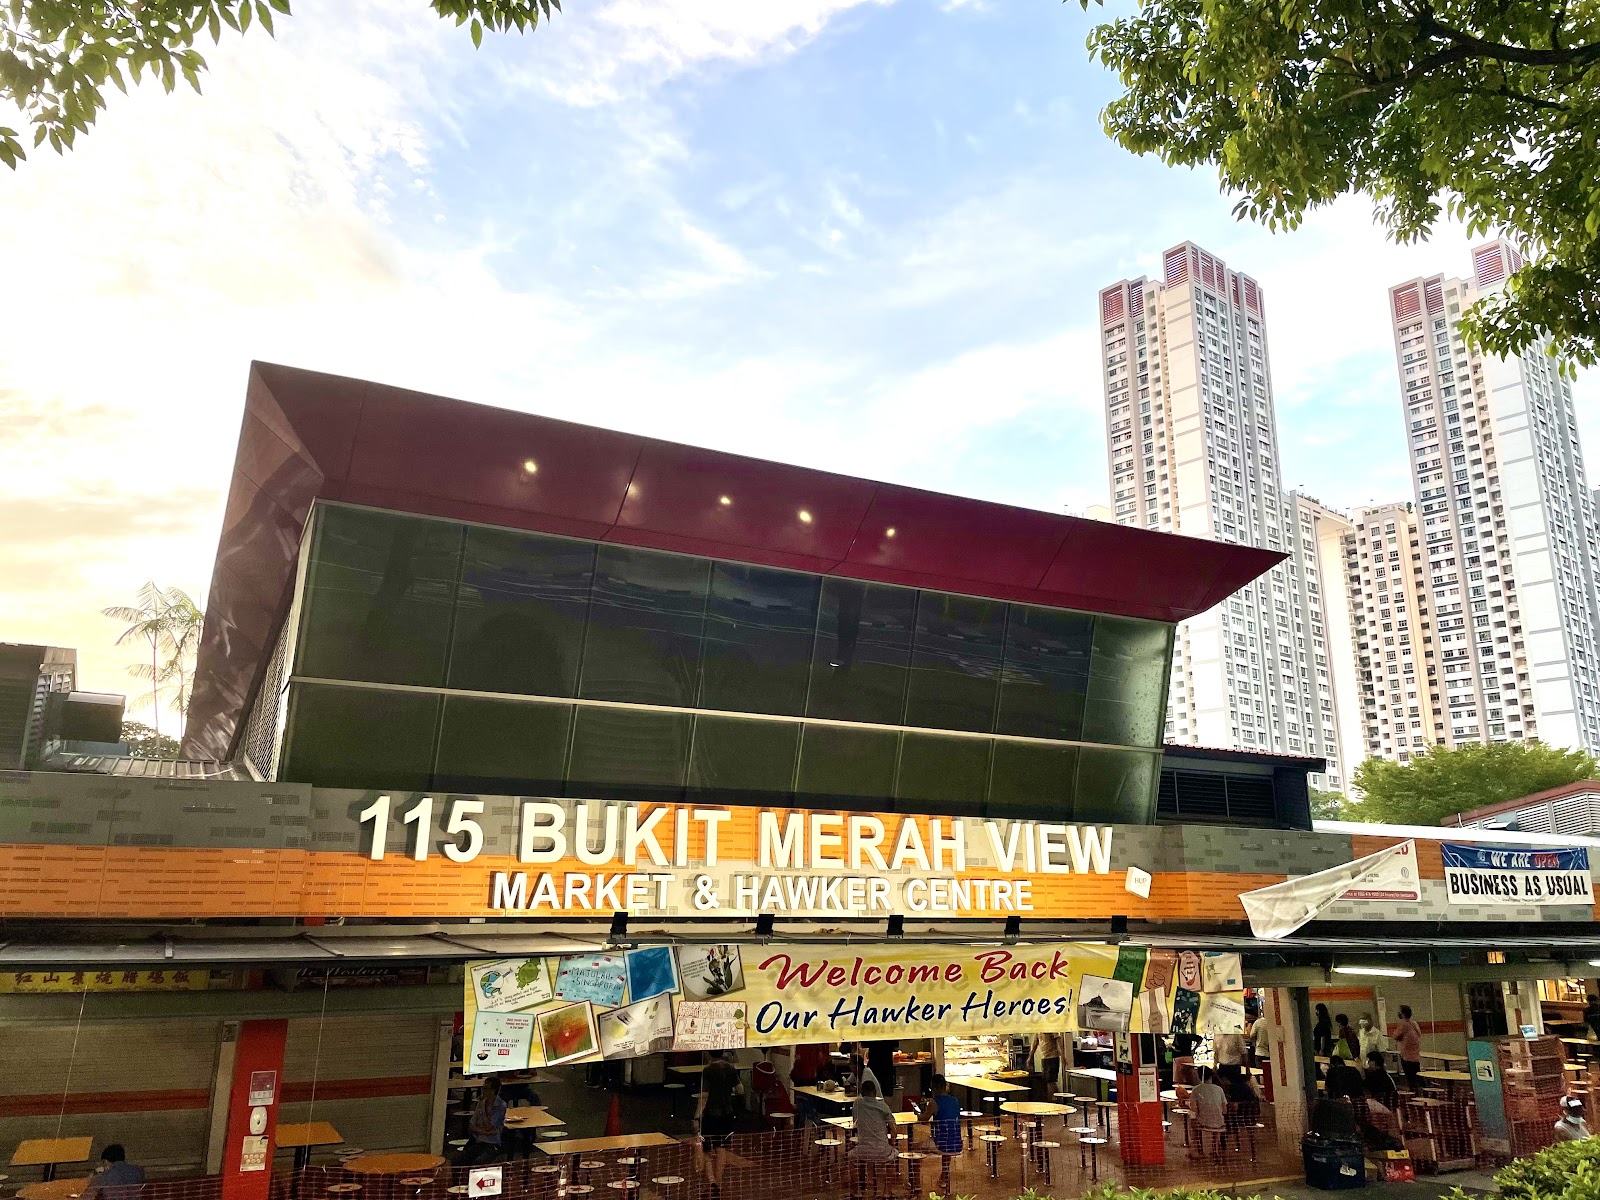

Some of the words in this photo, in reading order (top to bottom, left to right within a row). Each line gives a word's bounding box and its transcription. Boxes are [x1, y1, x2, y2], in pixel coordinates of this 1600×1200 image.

[360, 795, 484, 863] 115
[519, 801, 731, 867] BUKIT
[757, 810, 966, 872] MERAH
[983, 820, 1114, 875] VIEW
[1491, 852, 1508, 868] WE
[1511, 852, 1532, 868] ARE
[1533, 853, 1560, 868] OPEN
[491, 872, 676, 910] MARKET
[694, 874, 720, 910] &
[734, 874, 893, 911] HAWKER
[905, 878, 1034, 911] CENTRE
[1450, 873, 1518, 895] BUSINESS
[1525, 875, 1542, 896] AS
[1545, 875, 1589, 896] USUAL
[758, 953, 963, 990] Welcome
[974, 950, 1068, 984] Back
[755, 1001, 819, 1033] Our
[828, 995, 952, 1030] Hawker
[962, 988, 1073, 1027] Heroes!
